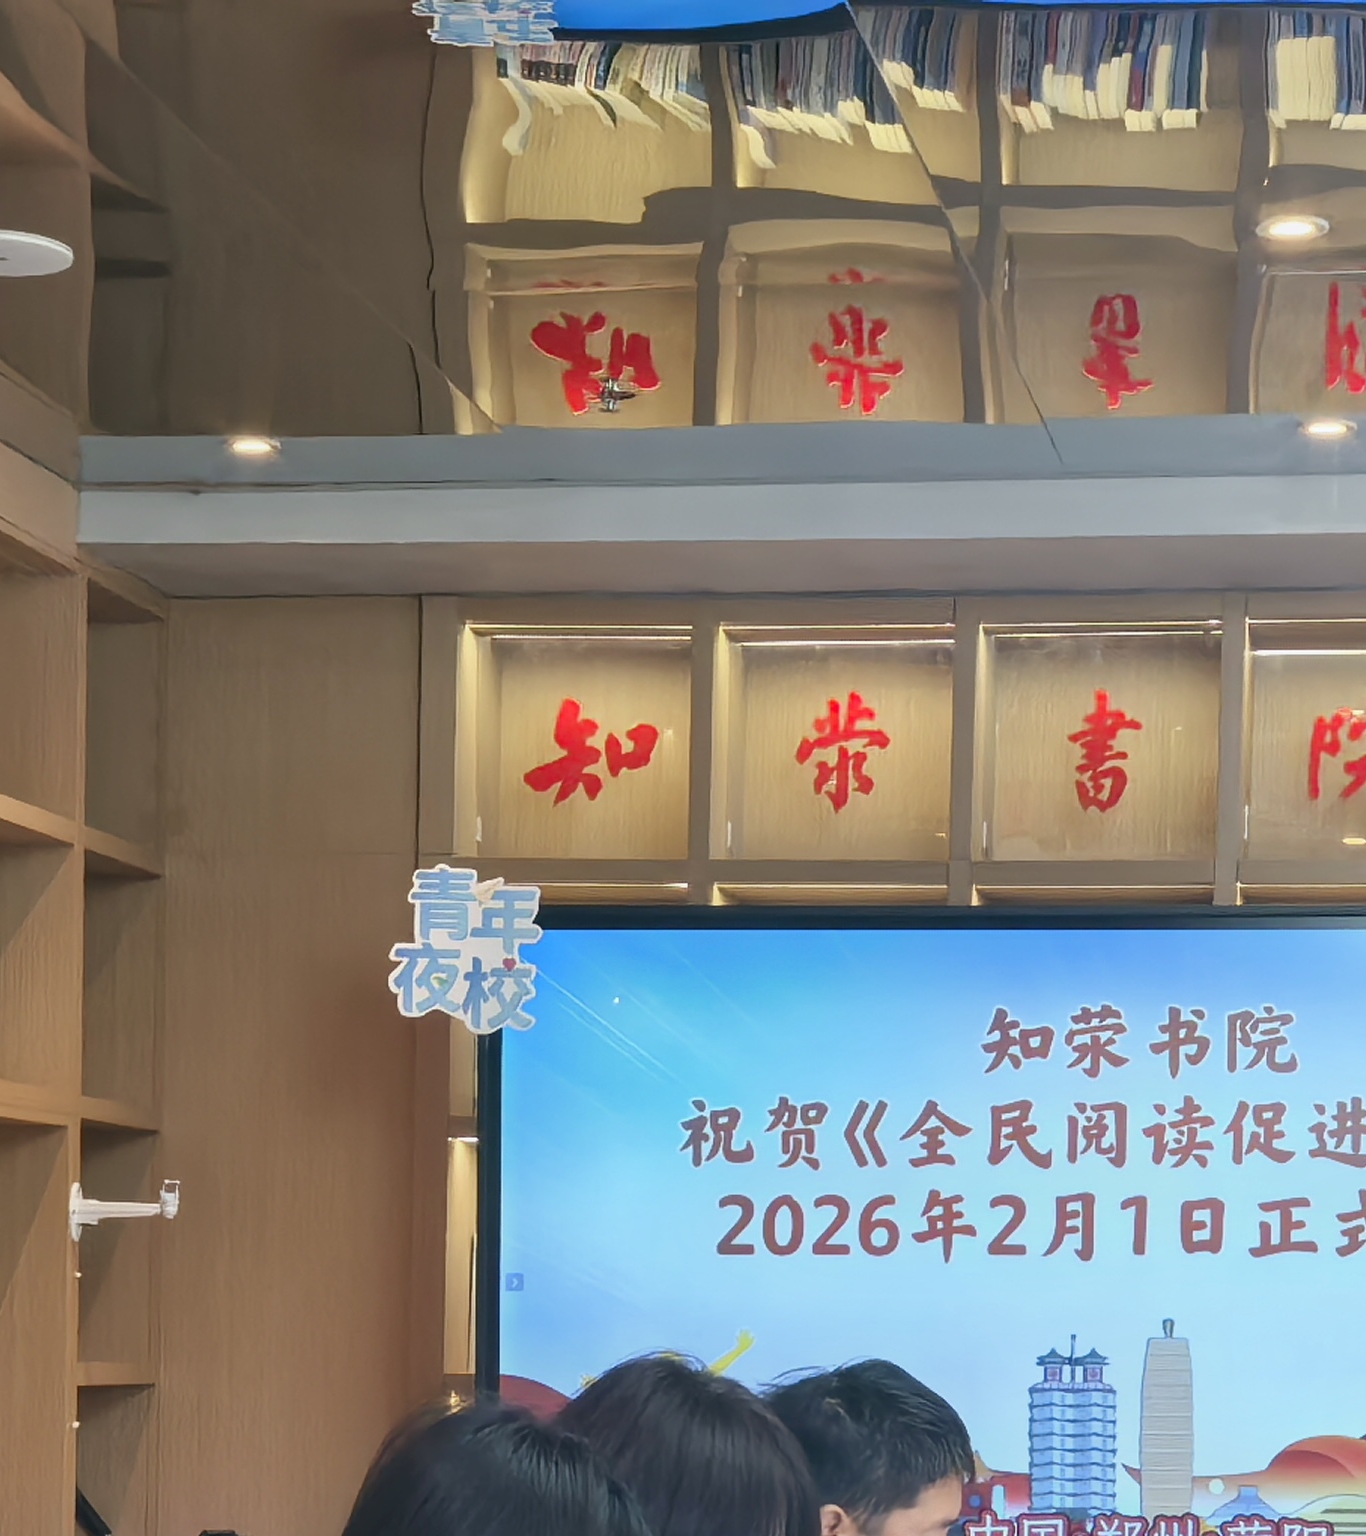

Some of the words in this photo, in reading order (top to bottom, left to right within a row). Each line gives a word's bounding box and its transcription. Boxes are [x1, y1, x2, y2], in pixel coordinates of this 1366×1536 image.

[410, 867, 543, 955] 青年
[393, 943, 537, 1030] 夜校
[982, 1003, 1299, 1081] 知荥书院
